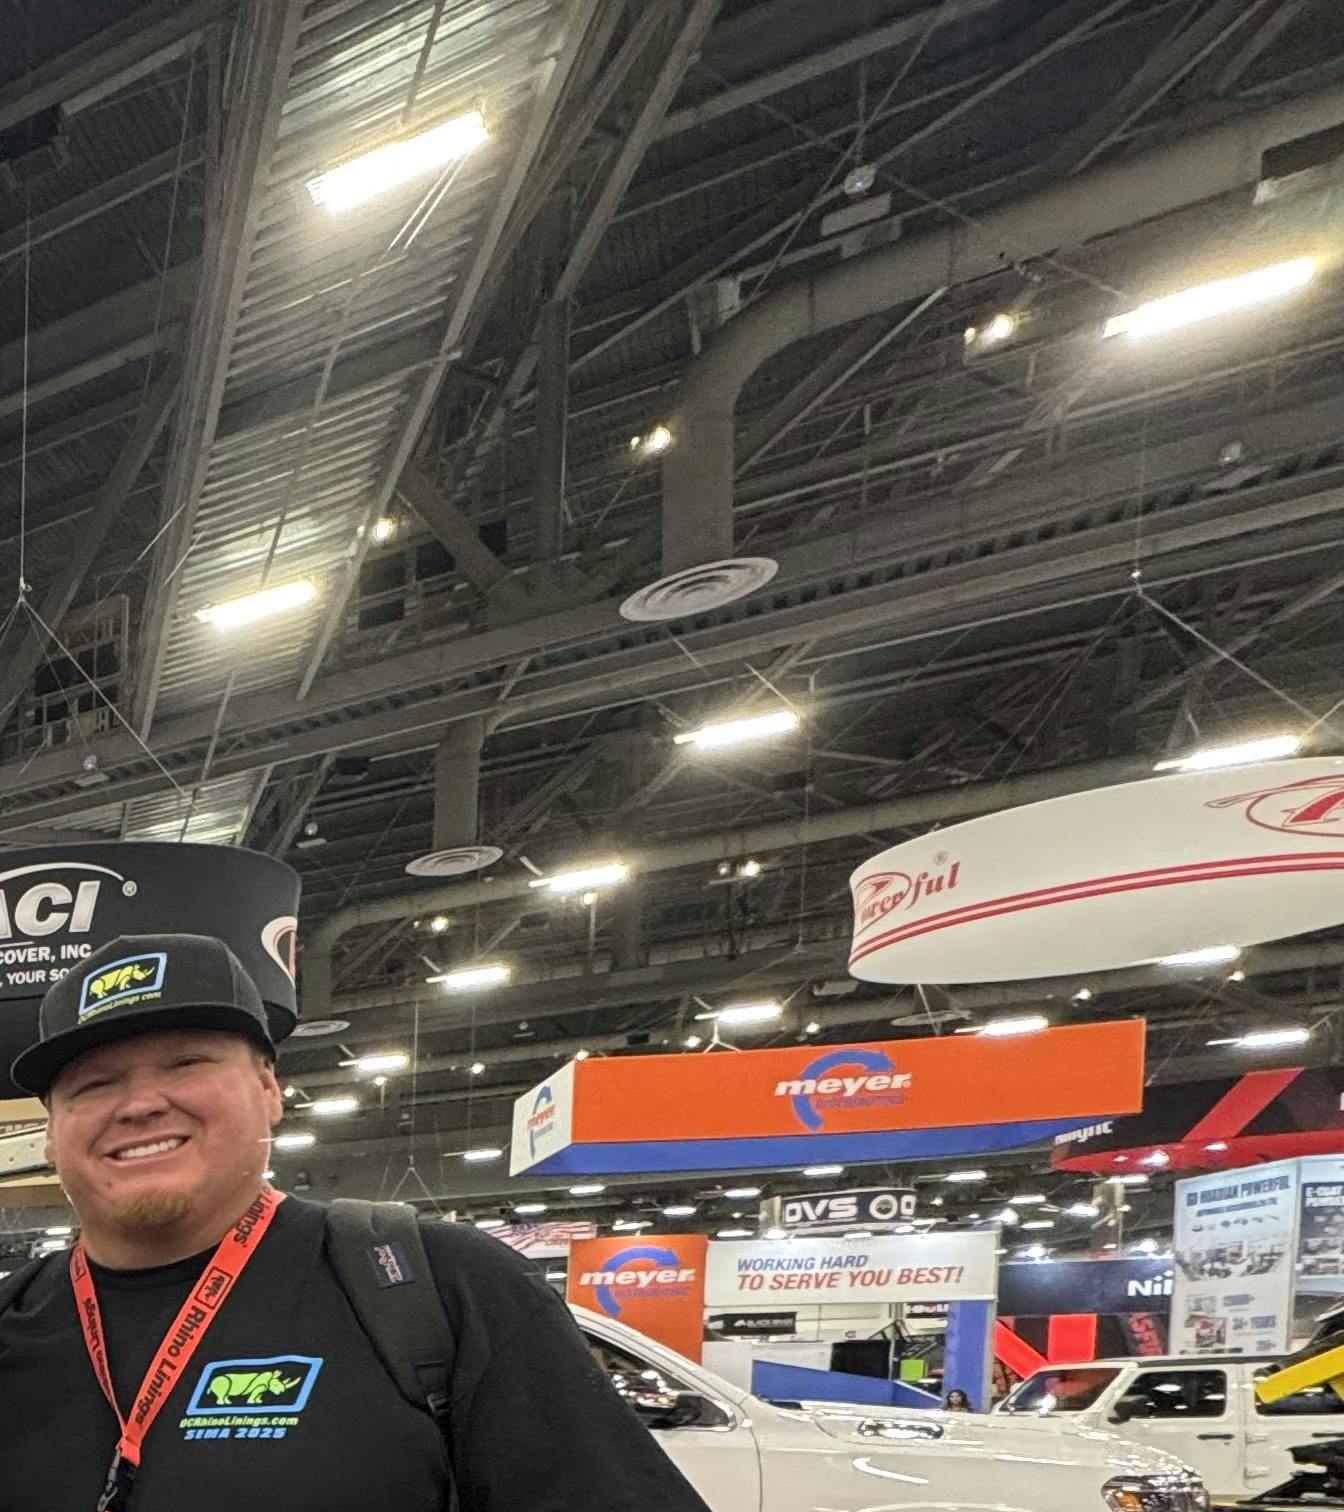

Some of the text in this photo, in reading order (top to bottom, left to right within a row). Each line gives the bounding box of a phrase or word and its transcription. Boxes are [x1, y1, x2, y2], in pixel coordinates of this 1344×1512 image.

[7, 971, 49, 985] YOUR
[774, 1073, 912, 1097] meyer
[737, 1254, 868, 1273] WORKING HARD
[578, 1268, 697, 1289] meyer
[737, 1266, 964, 1291] TO SERVE YOU BEST!
[135, 1304, 208, 1427] Rhino Linings
[183, 1427, 288, 1440] SEMA 2025
